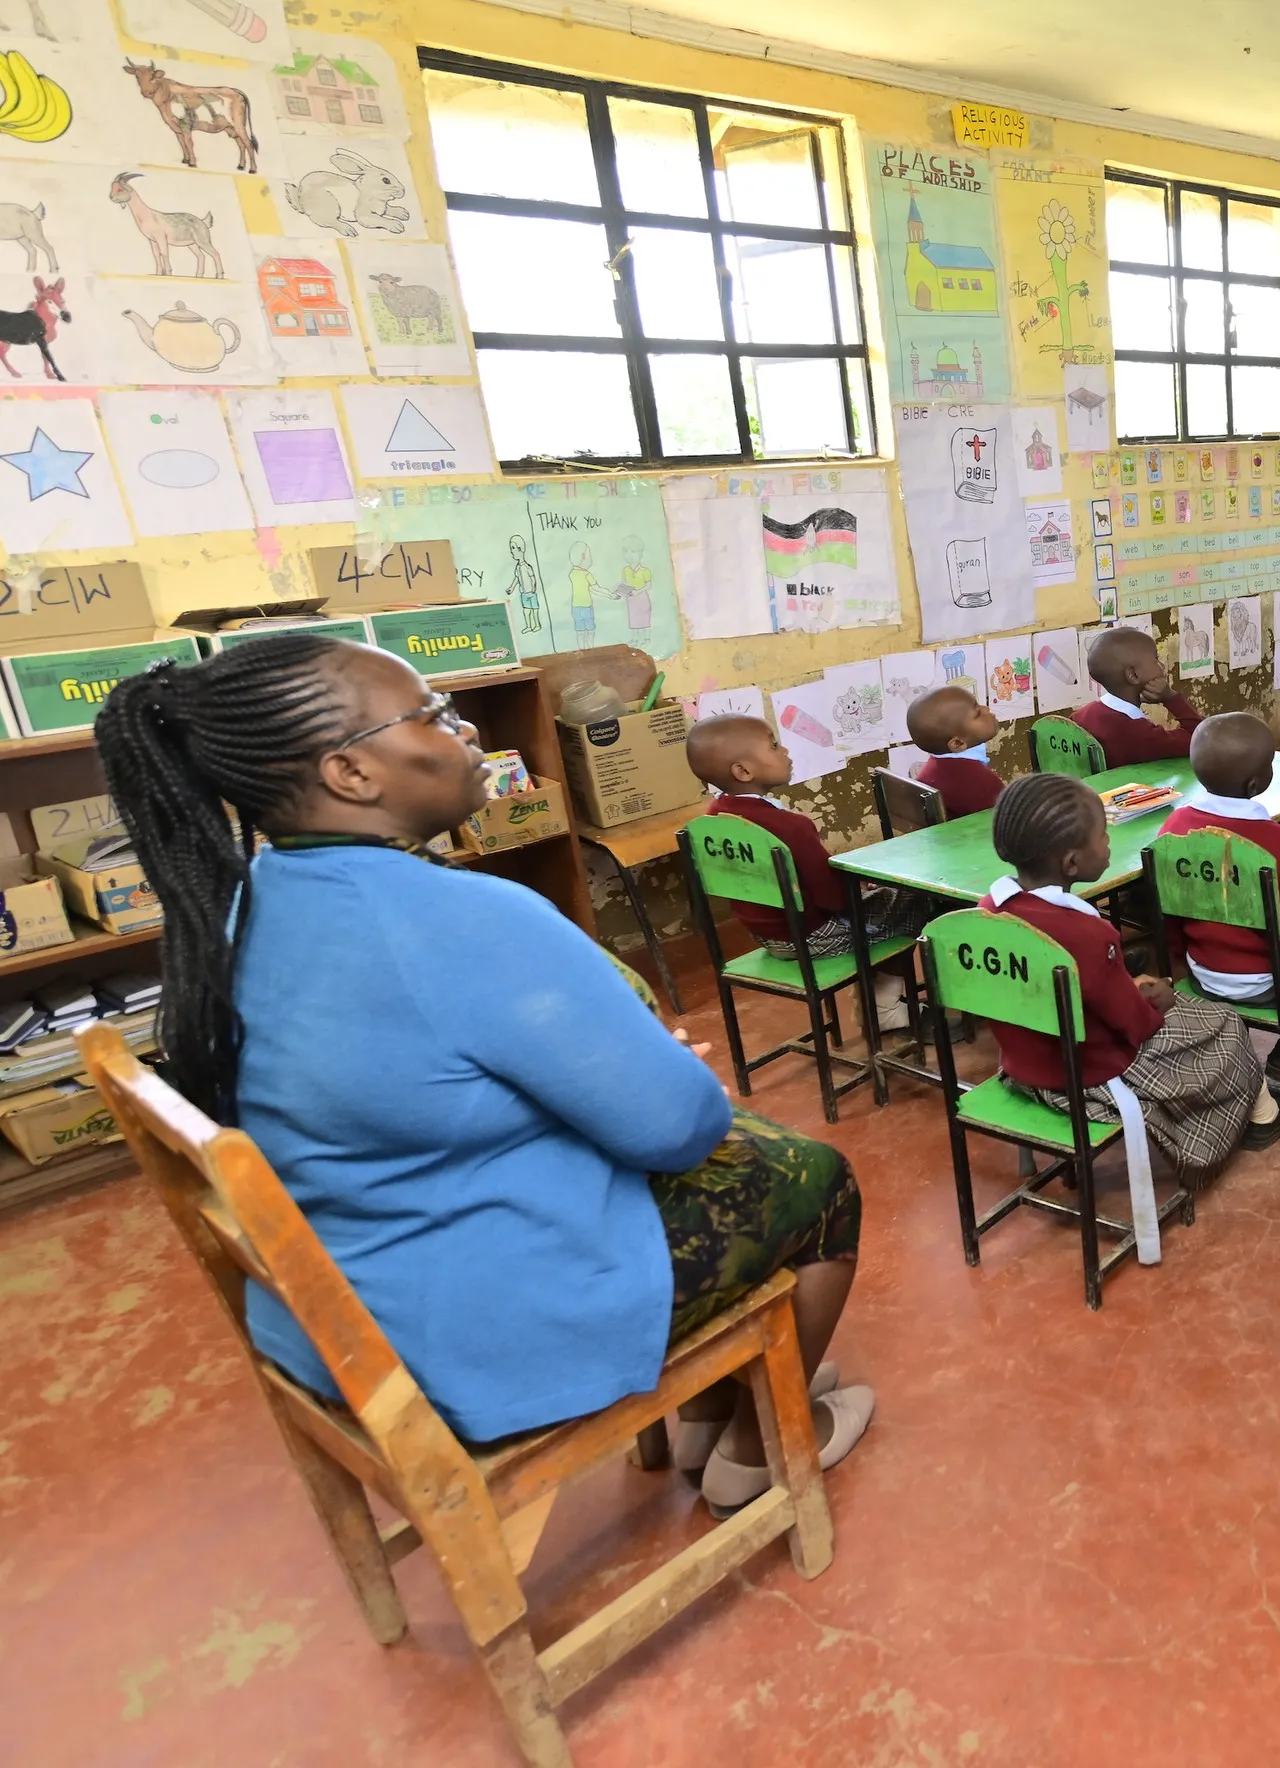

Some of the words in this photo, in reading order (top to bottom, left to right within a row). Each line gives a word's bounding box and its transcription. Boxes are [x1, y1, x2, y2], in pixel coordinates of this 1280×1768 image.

[960, 105, 1026, 131] RELIGIOUS
[962, 127, 1024, 149] ACTIVITY
[883, 148, 977, 178] PLACES
[921, 170, 983, 193] WORSHIP
[269, 410, 310, 425] Square
[947, 405, 975, 419] CRE
[391, 458, 457, 473] triangle
[536, 511, 579, 531] THANK
[582, 514, 603, 529] YOU
[1124, 544, 1139, 554] web
[1152, 542, 1165, 551] hen
[1203, 538, 1216, 547] bed
[1228, 535, 1239, 545] bell
[337, 551, 376, 594] 4
[379, 544, 434, 590] C/W
[800, 582, 835, 596] black
[801, 600, 824, 613] red
[406, 633, 485, 657] Family
[1049, 735, 1081, 757] C.G.N
[509, 799, 549, 821] ZENTA
[48, 808, 86, 838] 2
[703, 835, 755, 864] C.G.N
[958, 942, 1029, 984] C.G.N
